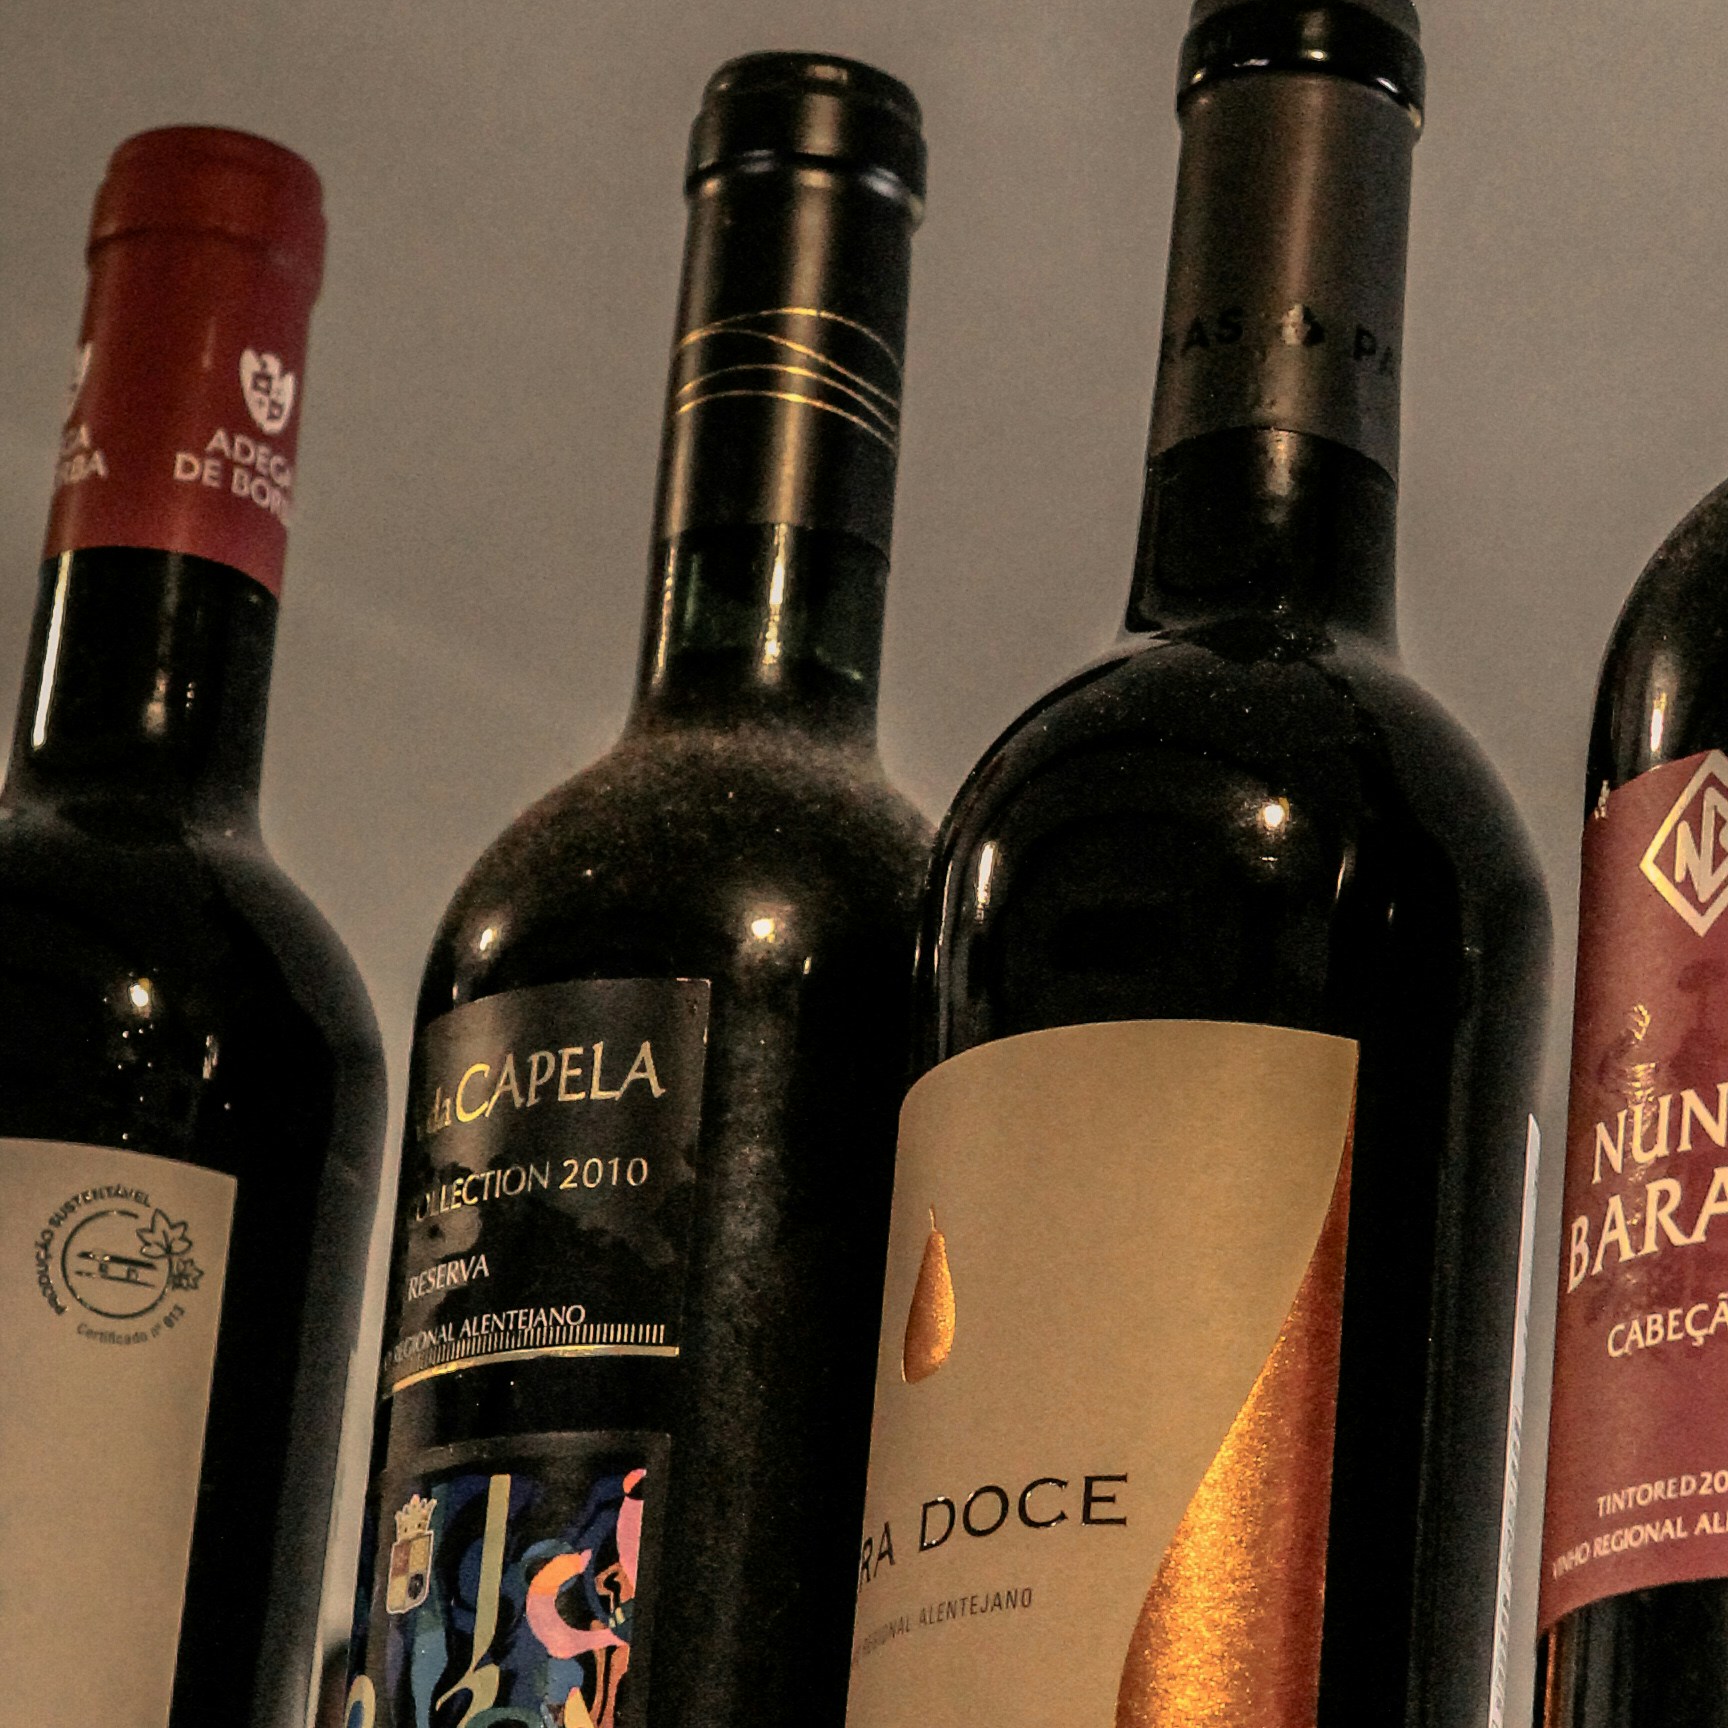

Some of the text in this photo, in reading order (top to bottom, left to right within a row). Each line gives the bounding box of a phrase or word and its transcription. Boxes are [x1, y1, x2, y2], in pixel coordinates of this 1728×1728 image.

[172, 452, 222, 489] DE
[205, 428, 293, 489] ADEG
[455, 1040, 667, 1123] CAPELA
[414, 1157, 650, 1223] OLLECTION 2010
[407, 1253, 490, 1302] RESERVA
[459, 1304, 587, 1339] ALENTEJANO
[858, 1472, 1129, 1594] RA DOCE
[1592, 1516, 1688, 1559] REGIONAL
[919, 1587, 1034, 1627] ALENTEJANO
